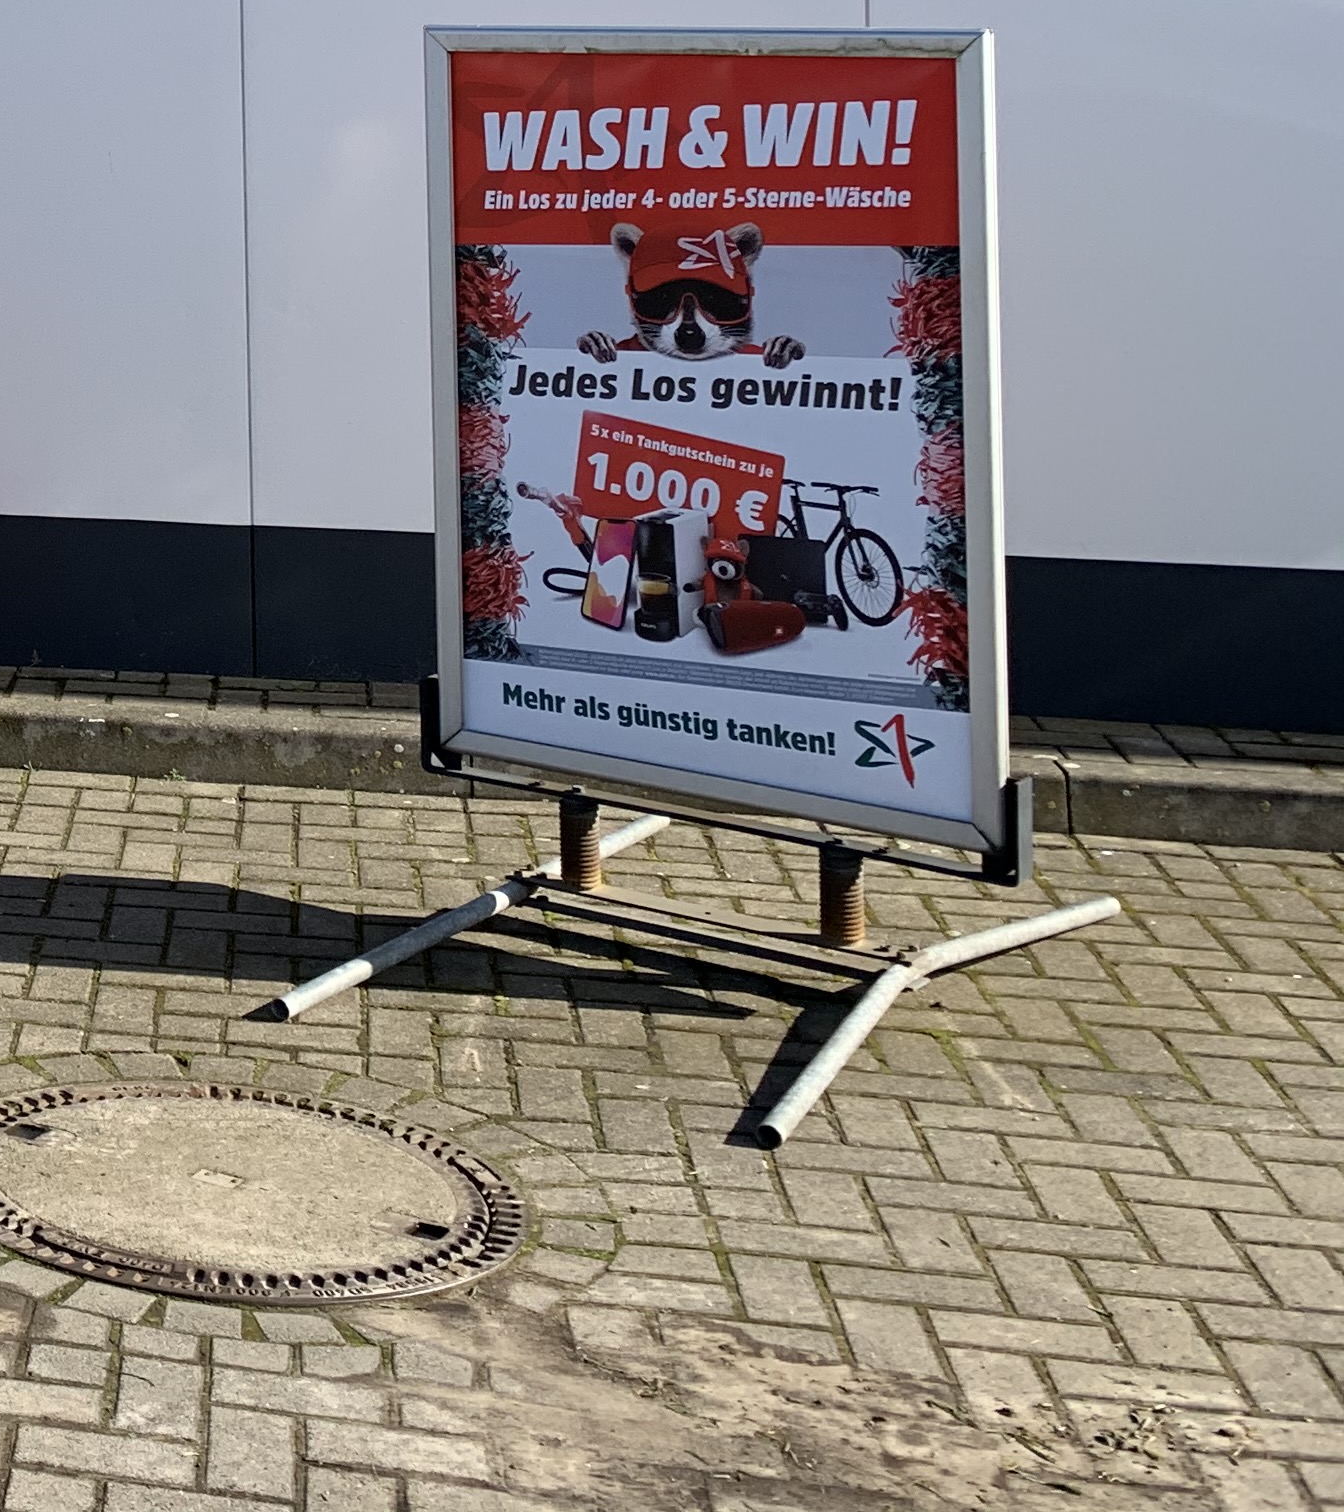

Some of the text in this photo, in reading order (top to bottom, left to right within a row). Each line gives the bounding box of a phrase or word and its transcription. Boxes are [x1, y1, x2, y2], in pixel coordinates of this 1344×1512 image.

[483, 99, 918, 171] WASH & WIN!
[484, 186, 912, 212] Ein Los zu jeder 4- oder 5-Sterne-Wäsche
[509, 364, 903, 412] Jedes Los gewinnt!
[612, 431, 634, 445] ein
[636, 434, 736, 469] Tankgutschein
[739, 460, 756, 474] zu
[759, 463, 774, 478] je
[587, 451, 769, 532] 1.000 €
[502, 682, 836, 756] Mehr als günstig tanken!
